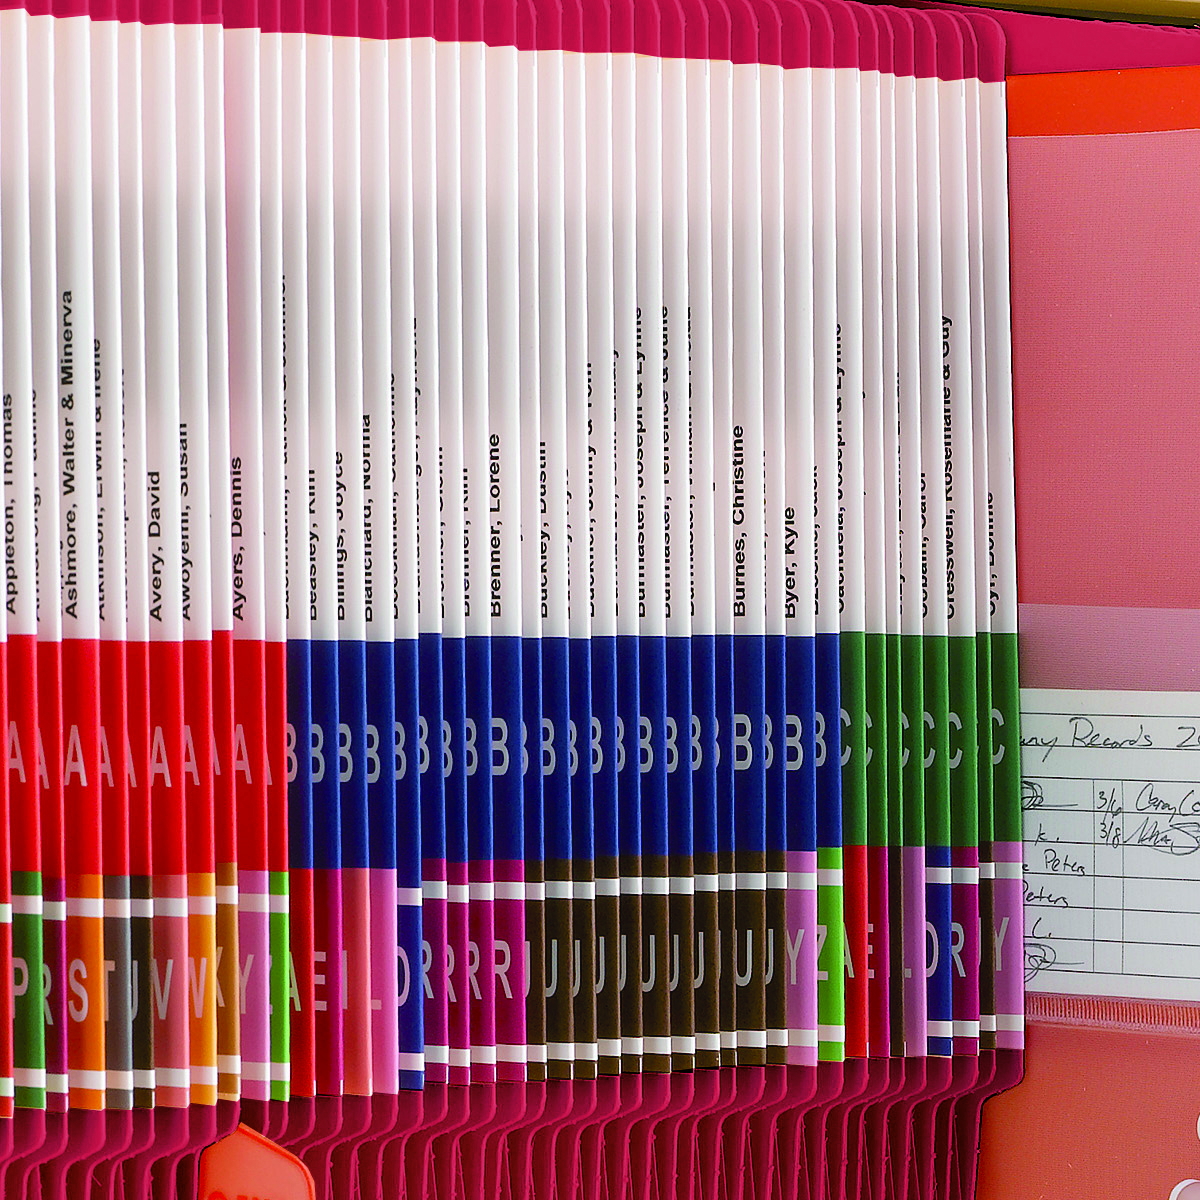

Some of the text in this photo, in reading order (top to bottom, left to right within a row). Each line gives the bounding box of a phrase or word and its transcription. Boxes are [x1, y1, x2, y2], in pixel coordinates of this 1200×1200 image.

[60, 291, 79, 619] Ashmore, Walter & Minerva
[148, 471, 164, 622] Avery, David
[231, 457, 246, 621] Ayers, Dennis
[490, 433, 503, 617] Brenner, Lorene
[732, 425, 747, 617] Burnes, Christine
[785, 507, 799, 619] Byer, Kyle
[7, 720, 26, 783] A
[64, 724, 88, 786] A
[151, 726, 172, 788] A
[234, 723, 252, 784] A
[367, 727, 381, 783] B
[491, 717, 510, 776] B
[639, 717, 654, 773] B
[733, 713, 752, 770] B
[787, 715, 803, 770] B
[948, 713, 963, 768] C
[1100, 821, 1120, 848] 3/8
[495, 940, 511, 998] R
[735, 930, 753, 986] U
[787, 929, 806, 985] Y
[951, 922, 966, 978] R
[12, 959, 29, 1019] P
[69, 960, 88, 1022] S
[153, 960, 174, 1020] V
